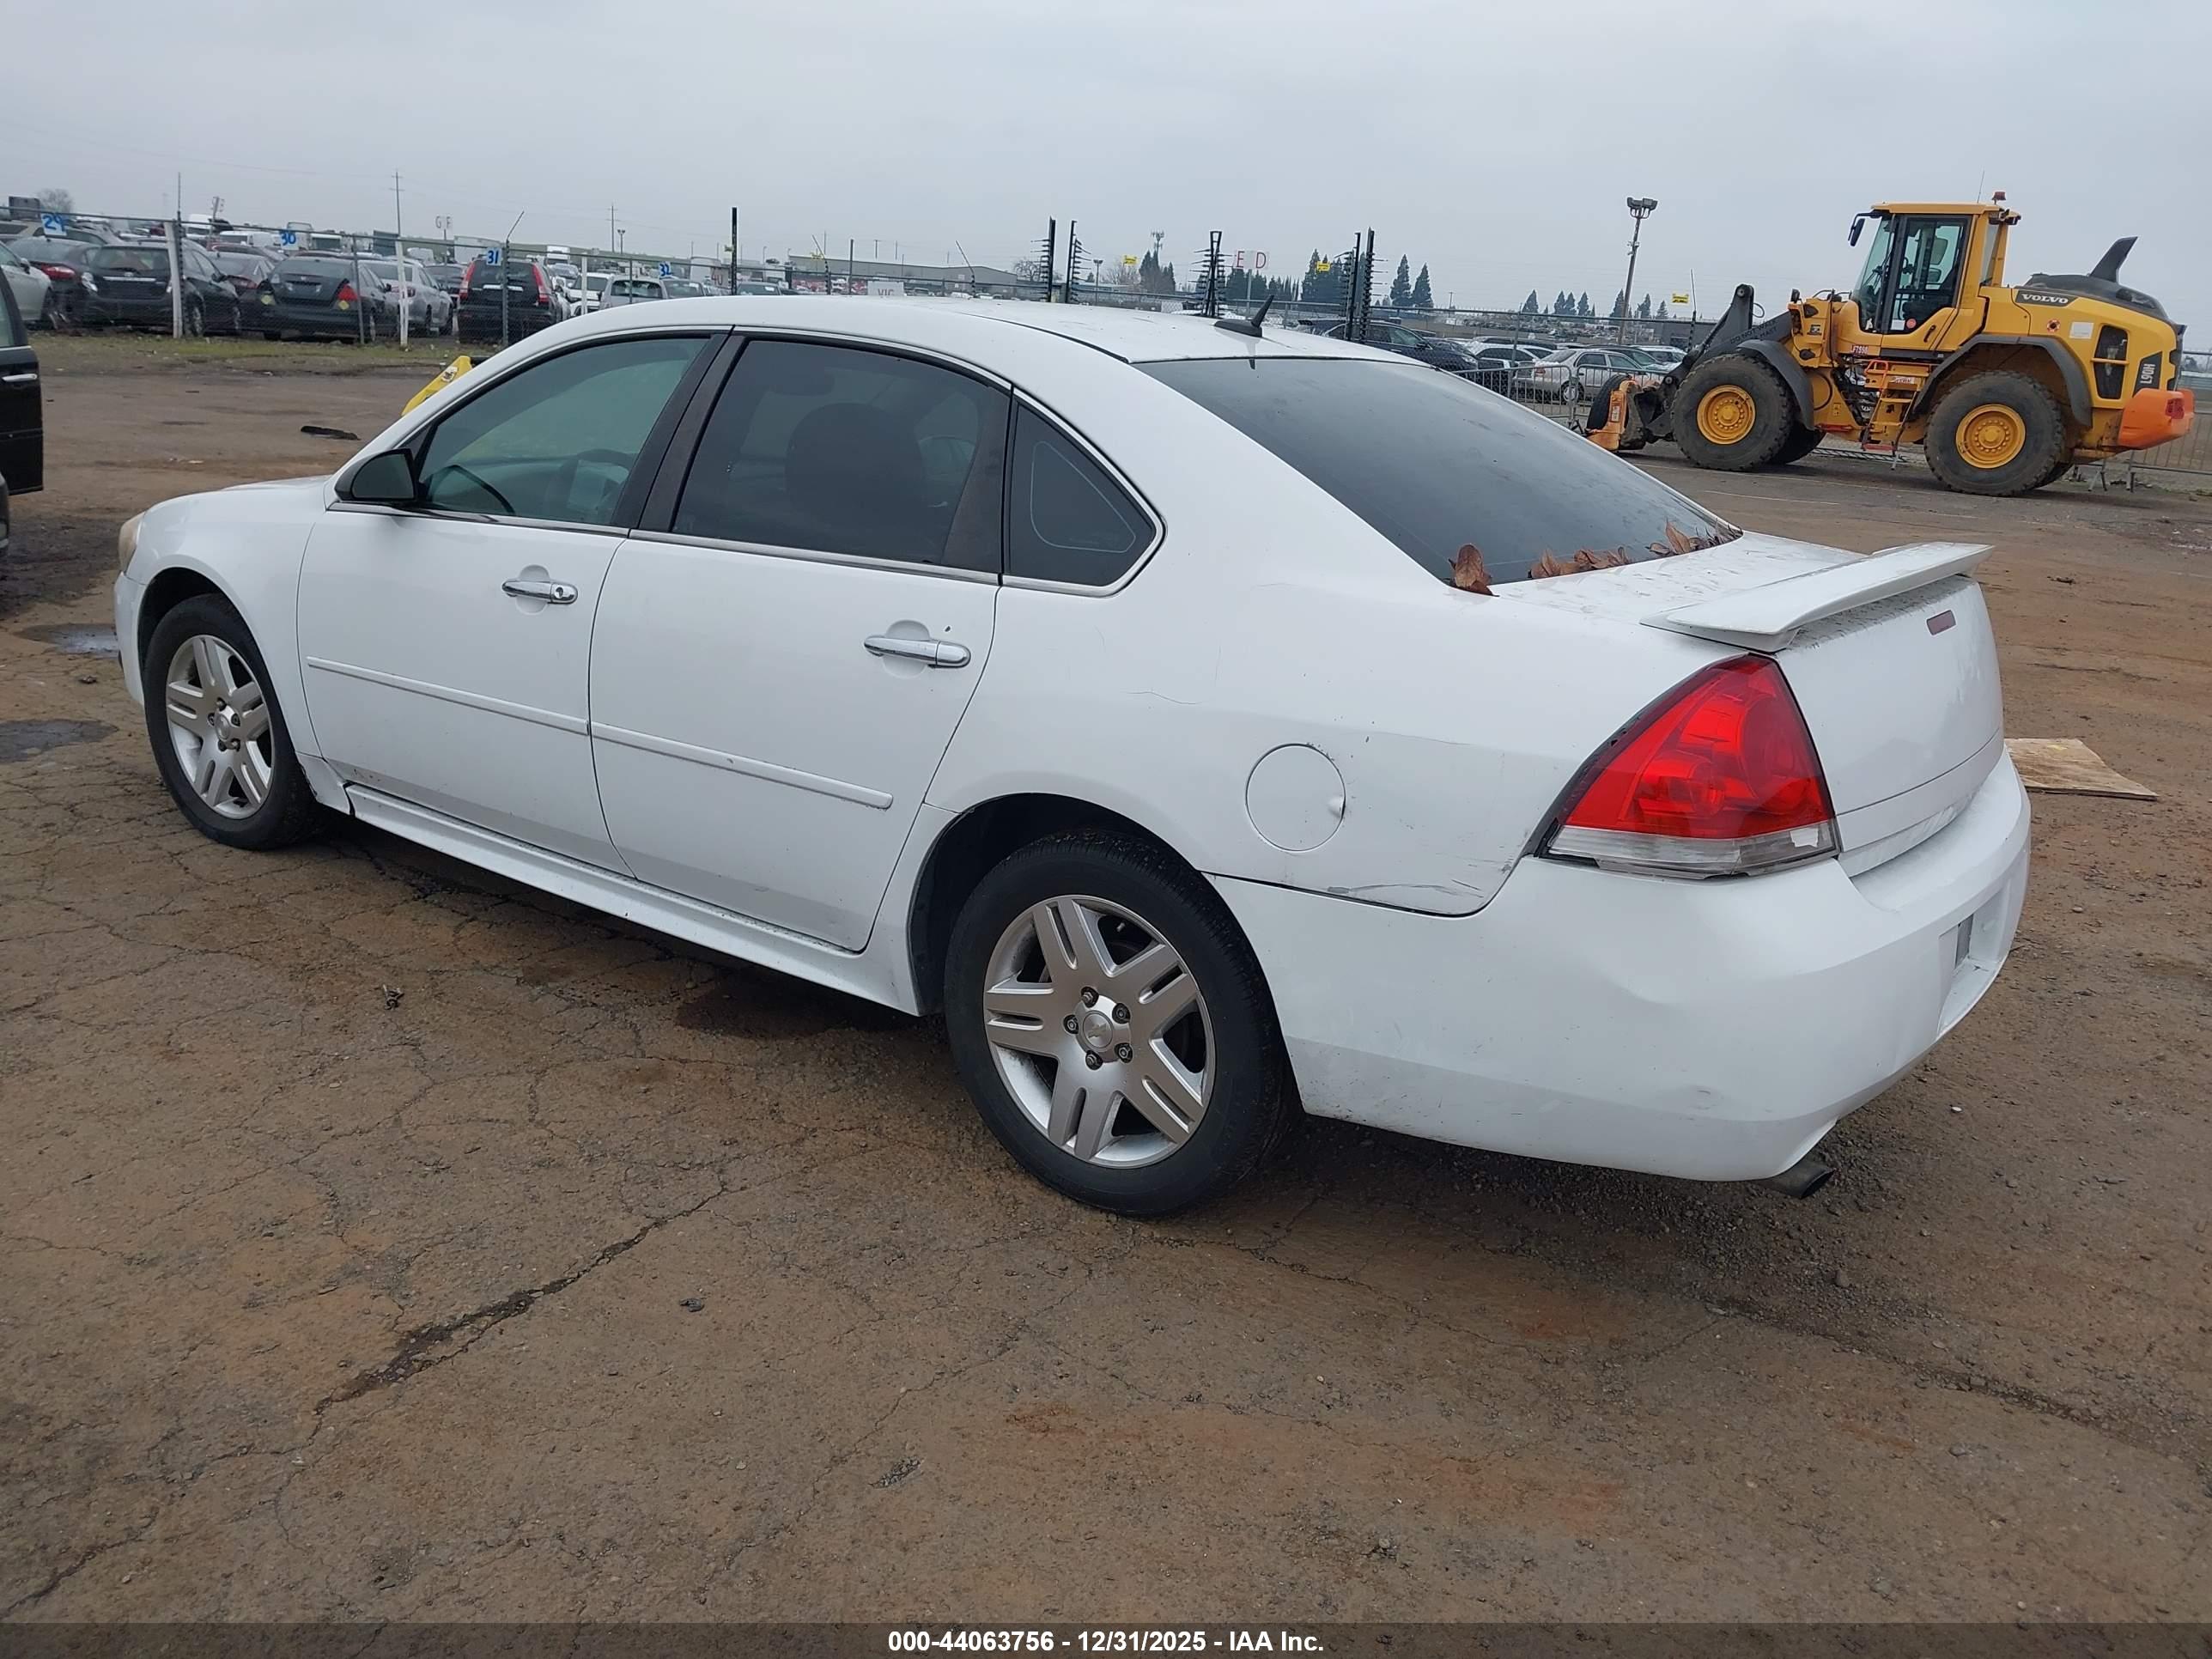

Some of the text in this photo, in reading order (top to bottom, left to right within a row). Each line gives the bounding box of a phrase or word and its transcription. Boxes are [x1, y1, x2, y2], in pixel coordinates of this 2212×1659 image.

[280, 230, 296, 246] 30
[487, 250, 500, 264] 31
[659, 262, 673, 276] 32
[2022, 294, 2069, 304] VOLVO
[2140, 363, 2156, 385] L90H
